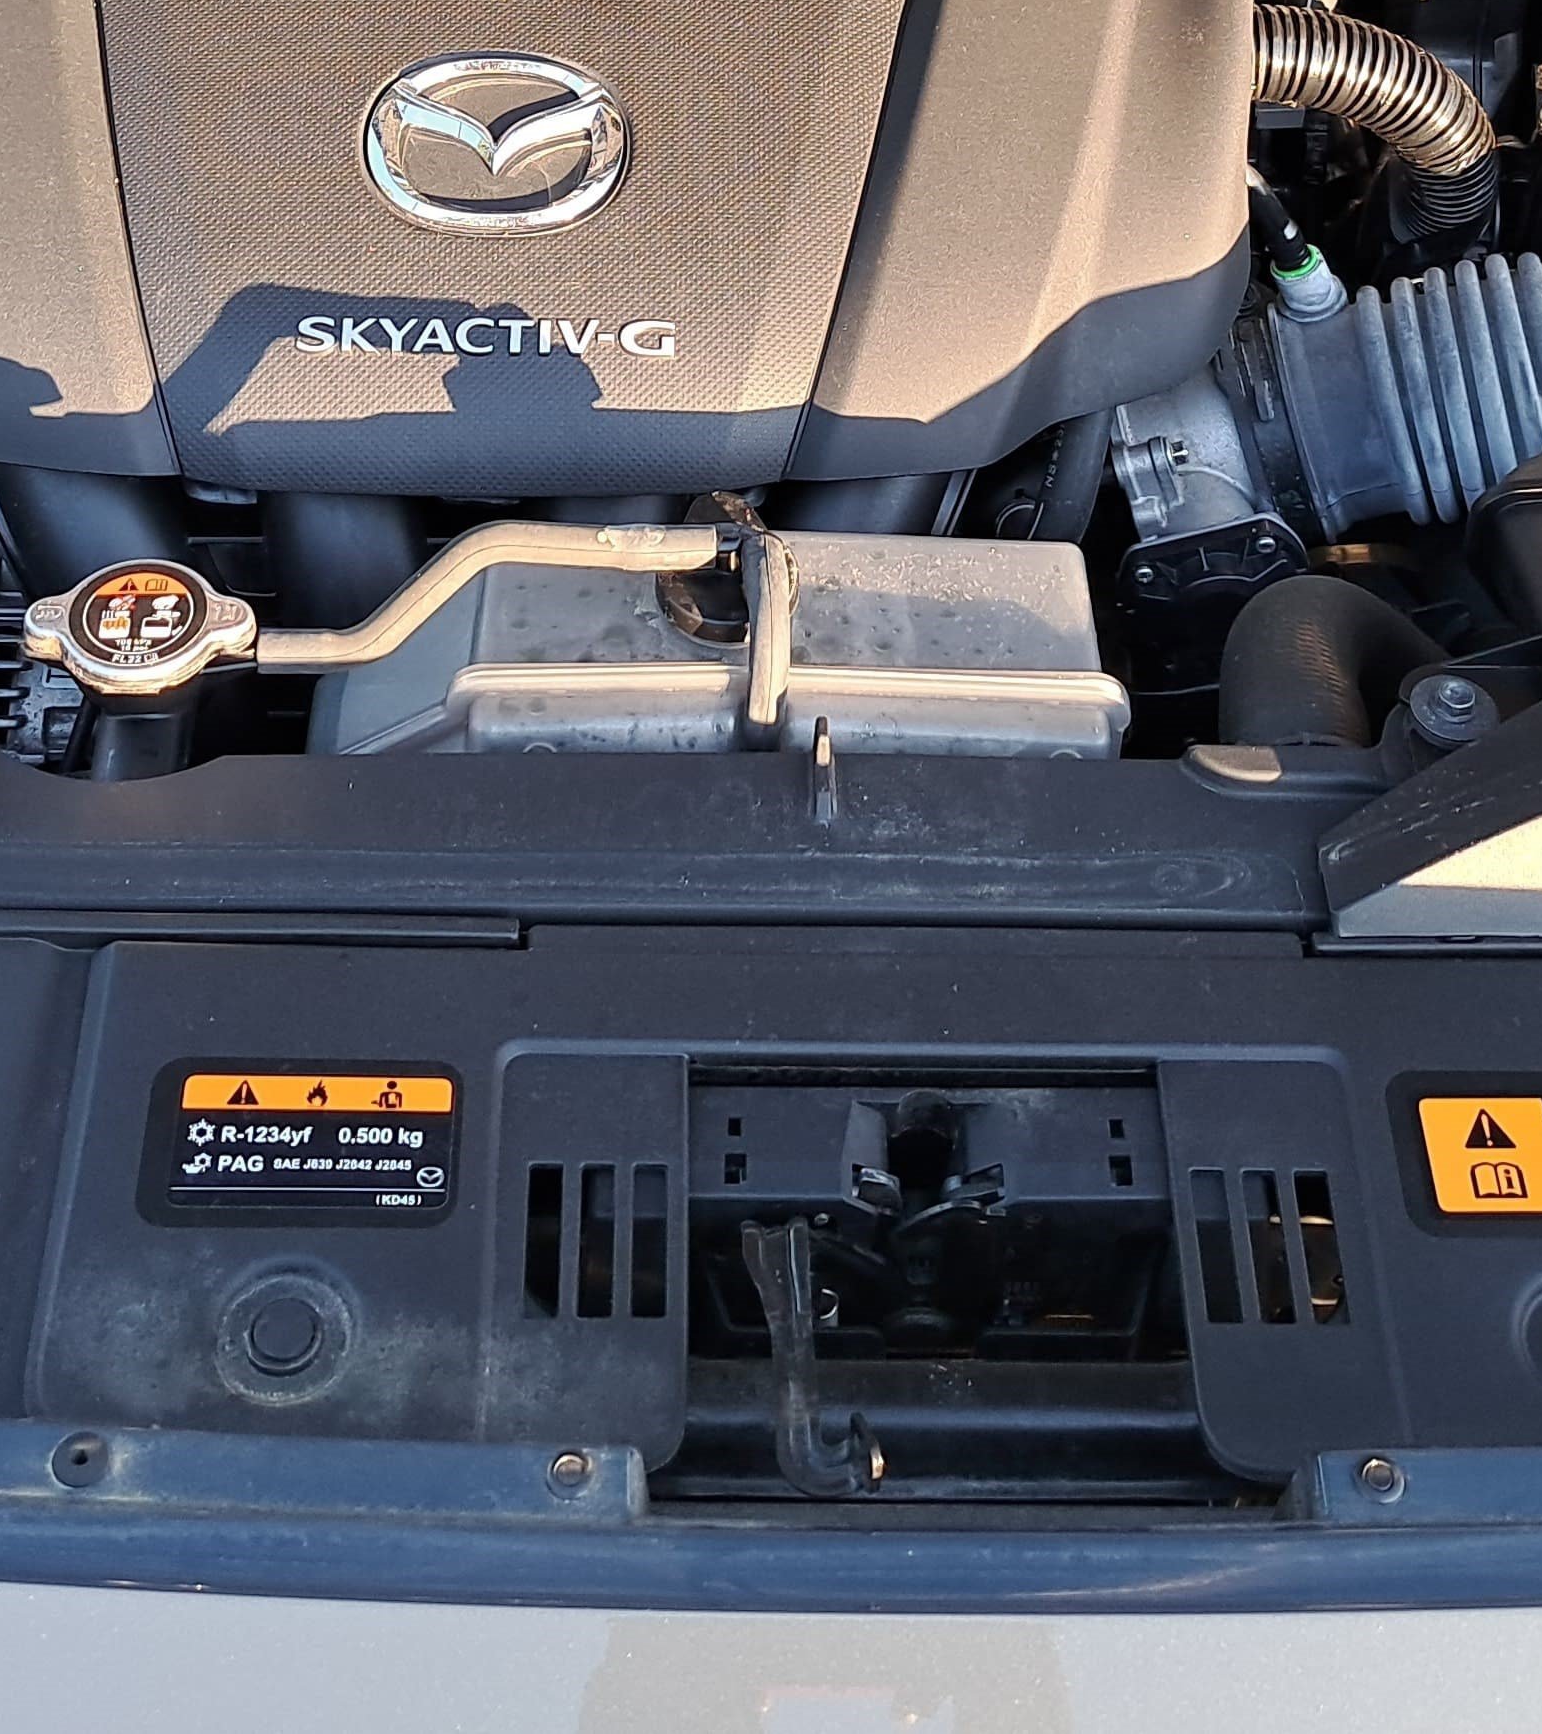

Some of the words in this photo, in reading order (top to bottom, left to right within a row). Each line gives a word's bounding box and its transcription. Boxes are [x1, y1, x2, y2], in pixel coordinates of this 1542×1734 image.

[295, 316, 676, 357] SKYACTIV-G
[220, 1125, 314, 1147] R-1234yf
[337, 1127, 393, 1144] 0.500
[397, 1127, 424, 1148] kg
[217, 1155, 264, 1172] PAG
[273, 1158, 301, 1170] SAE
